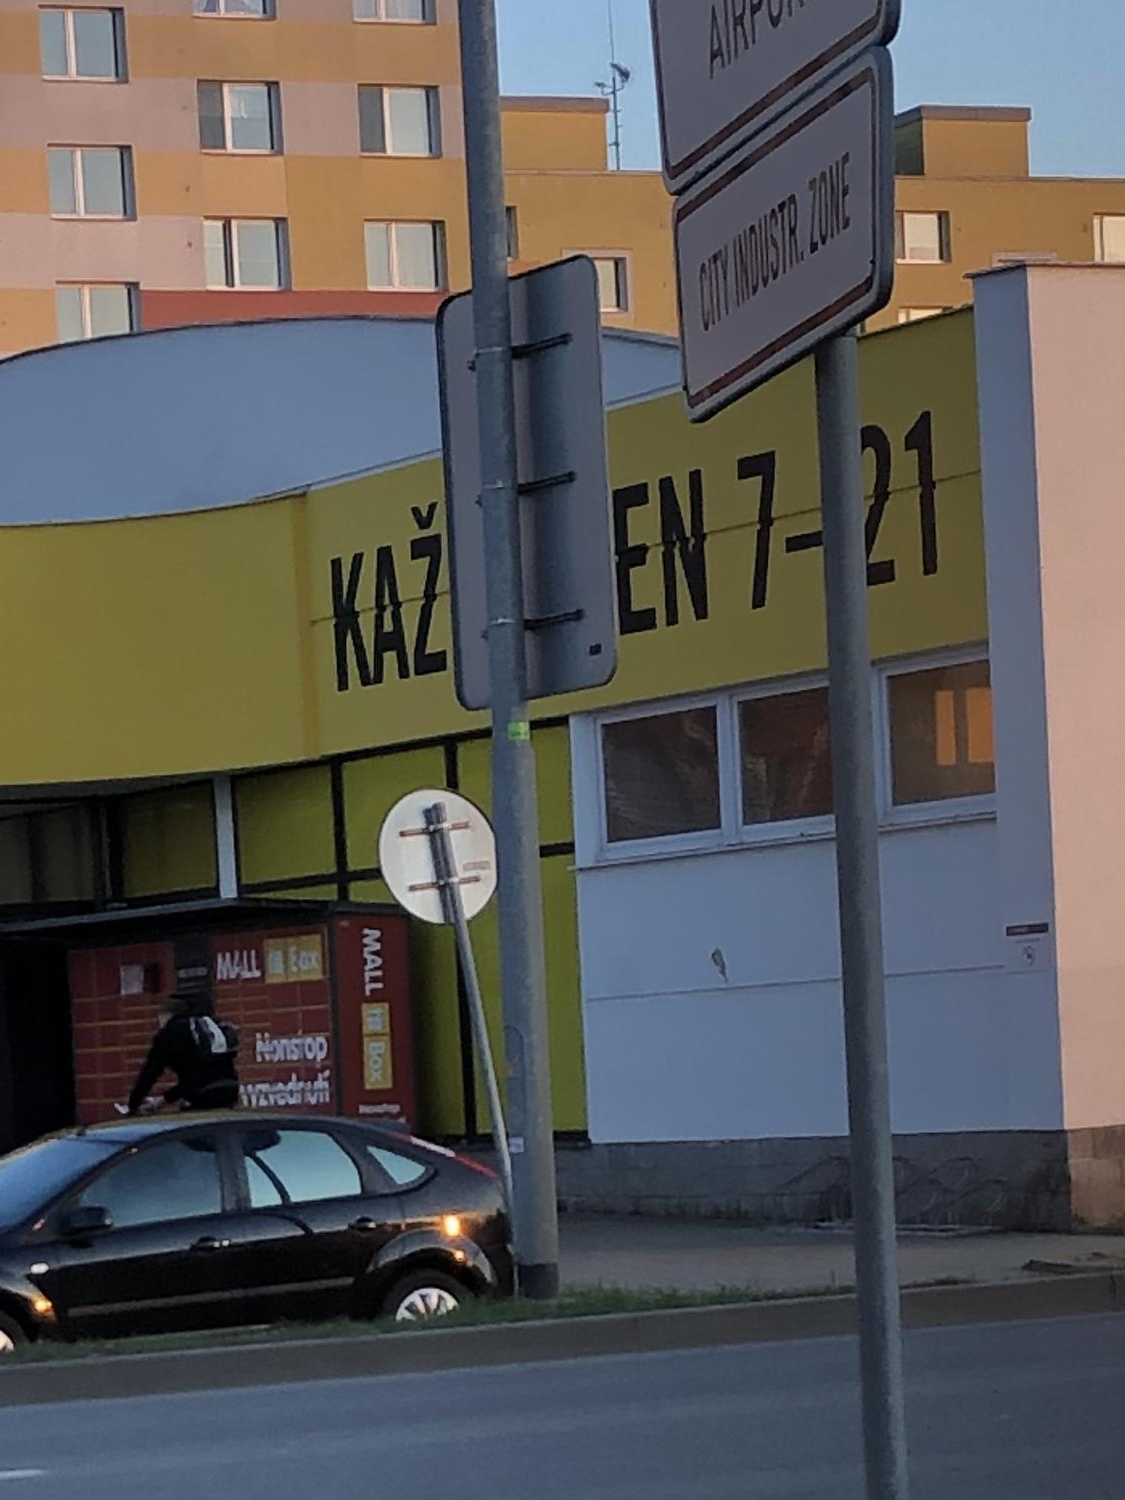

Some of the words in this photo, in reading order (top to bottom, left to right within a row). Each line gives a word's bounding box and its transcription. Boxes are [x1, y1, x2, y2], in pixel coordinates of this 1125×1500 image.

[709, 0, 805, 80] AIRP
[698, 246, 731, 332] CITY
[732, 194, 804, 308] INDUSTR.
[808, 152, 851, 254] ZONE
[330, 502, 448, 692] KAŽ
[612, 468, 709, 636] EN
[216, 948, 262, 981] MALL
[362, 927, 385, 996] MALL
[255, 1030, 328, 1063] Nonstop
